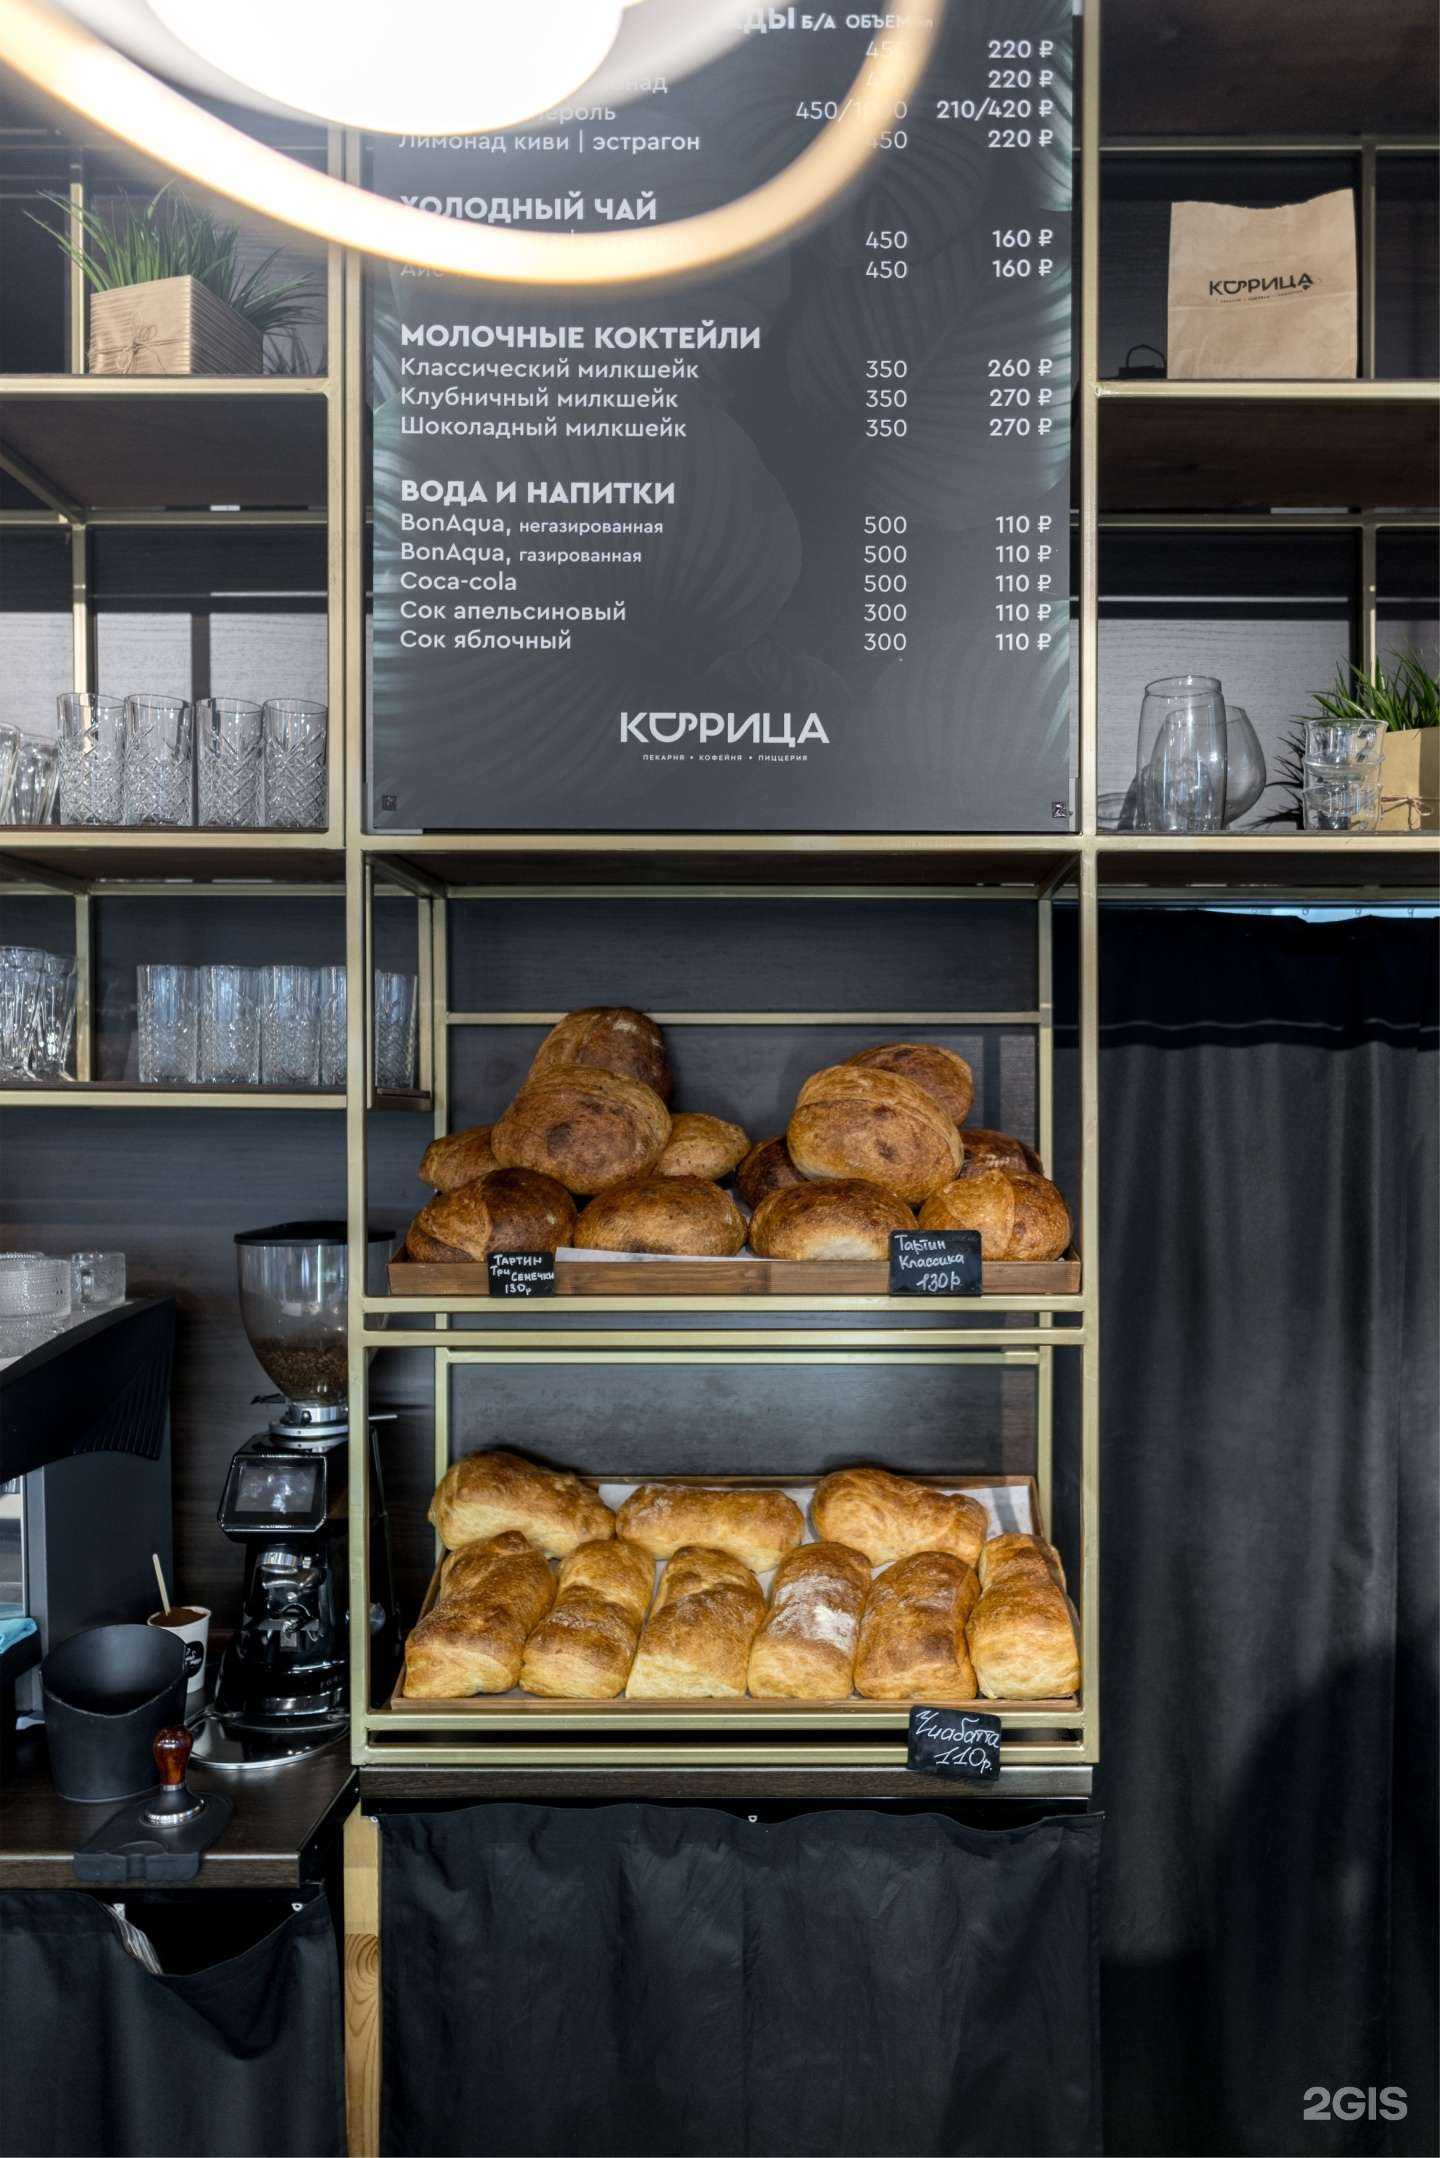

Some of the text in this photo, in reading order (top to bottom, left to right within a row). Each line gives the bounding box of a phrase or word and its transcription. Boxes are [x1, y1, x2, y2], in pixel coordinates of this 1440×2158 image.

[802, 13, 836, 31] Б/А
[865, 40, 1053, 58] 45 220 ₽
[989, 70, 1054, 88] 220 ₽
[796, 100, 907, 121] 450/10
[937, 98, 1031, 120] 210/420
[1039, 100, 1053, 117] ₽
[399, 134, 506, 152] Лимонад
[515, 137, 568, 149] киви
[593, 137, 699, 154] эстрагон
[989, 130, 1031, 147] 220
[1039, 130, 1053, 147] ₽
[595, 191, 656, 220] ЧАЙ
[866, 229, 1052, 249] 450 160 ₽
[866, 259, 1052, 278] 450 160 ₽
[401, 320, 759, 349] МОЛОЧНЫЕ КОКТЕЙЛИ
[402, 358, 1054, 378] Классический милкшейк 350 260 ₽
[402, 386, 1052, 409] Клубничный милкшейк 350 270 ₽
[402, 417, 1052, 438] Шоколадный милкшейк 350 270 ₽
[402, 480, 674, 506] ВОДА И НАПИТКИ
[402, 513, 1051, 536] BonAqua, негазированная 500 110 ₽
[402, 543, 1051, 565] BonAqua, газированная 500 110 ₽
[400, 571, 1051, 592] Coca-cola 500 110 ₽
[401, 601, 1051, 621] Сок апельсиновый 300 110 ₽
[401, 629, 1051, 650] Сок яблочный 300 110 ₽
[759, 753, 807, 761] ПИЦЦЕРИЯ
[894, 1234, 946, 1255] Тартин
[899, 1254, 964, 1270] Классика
